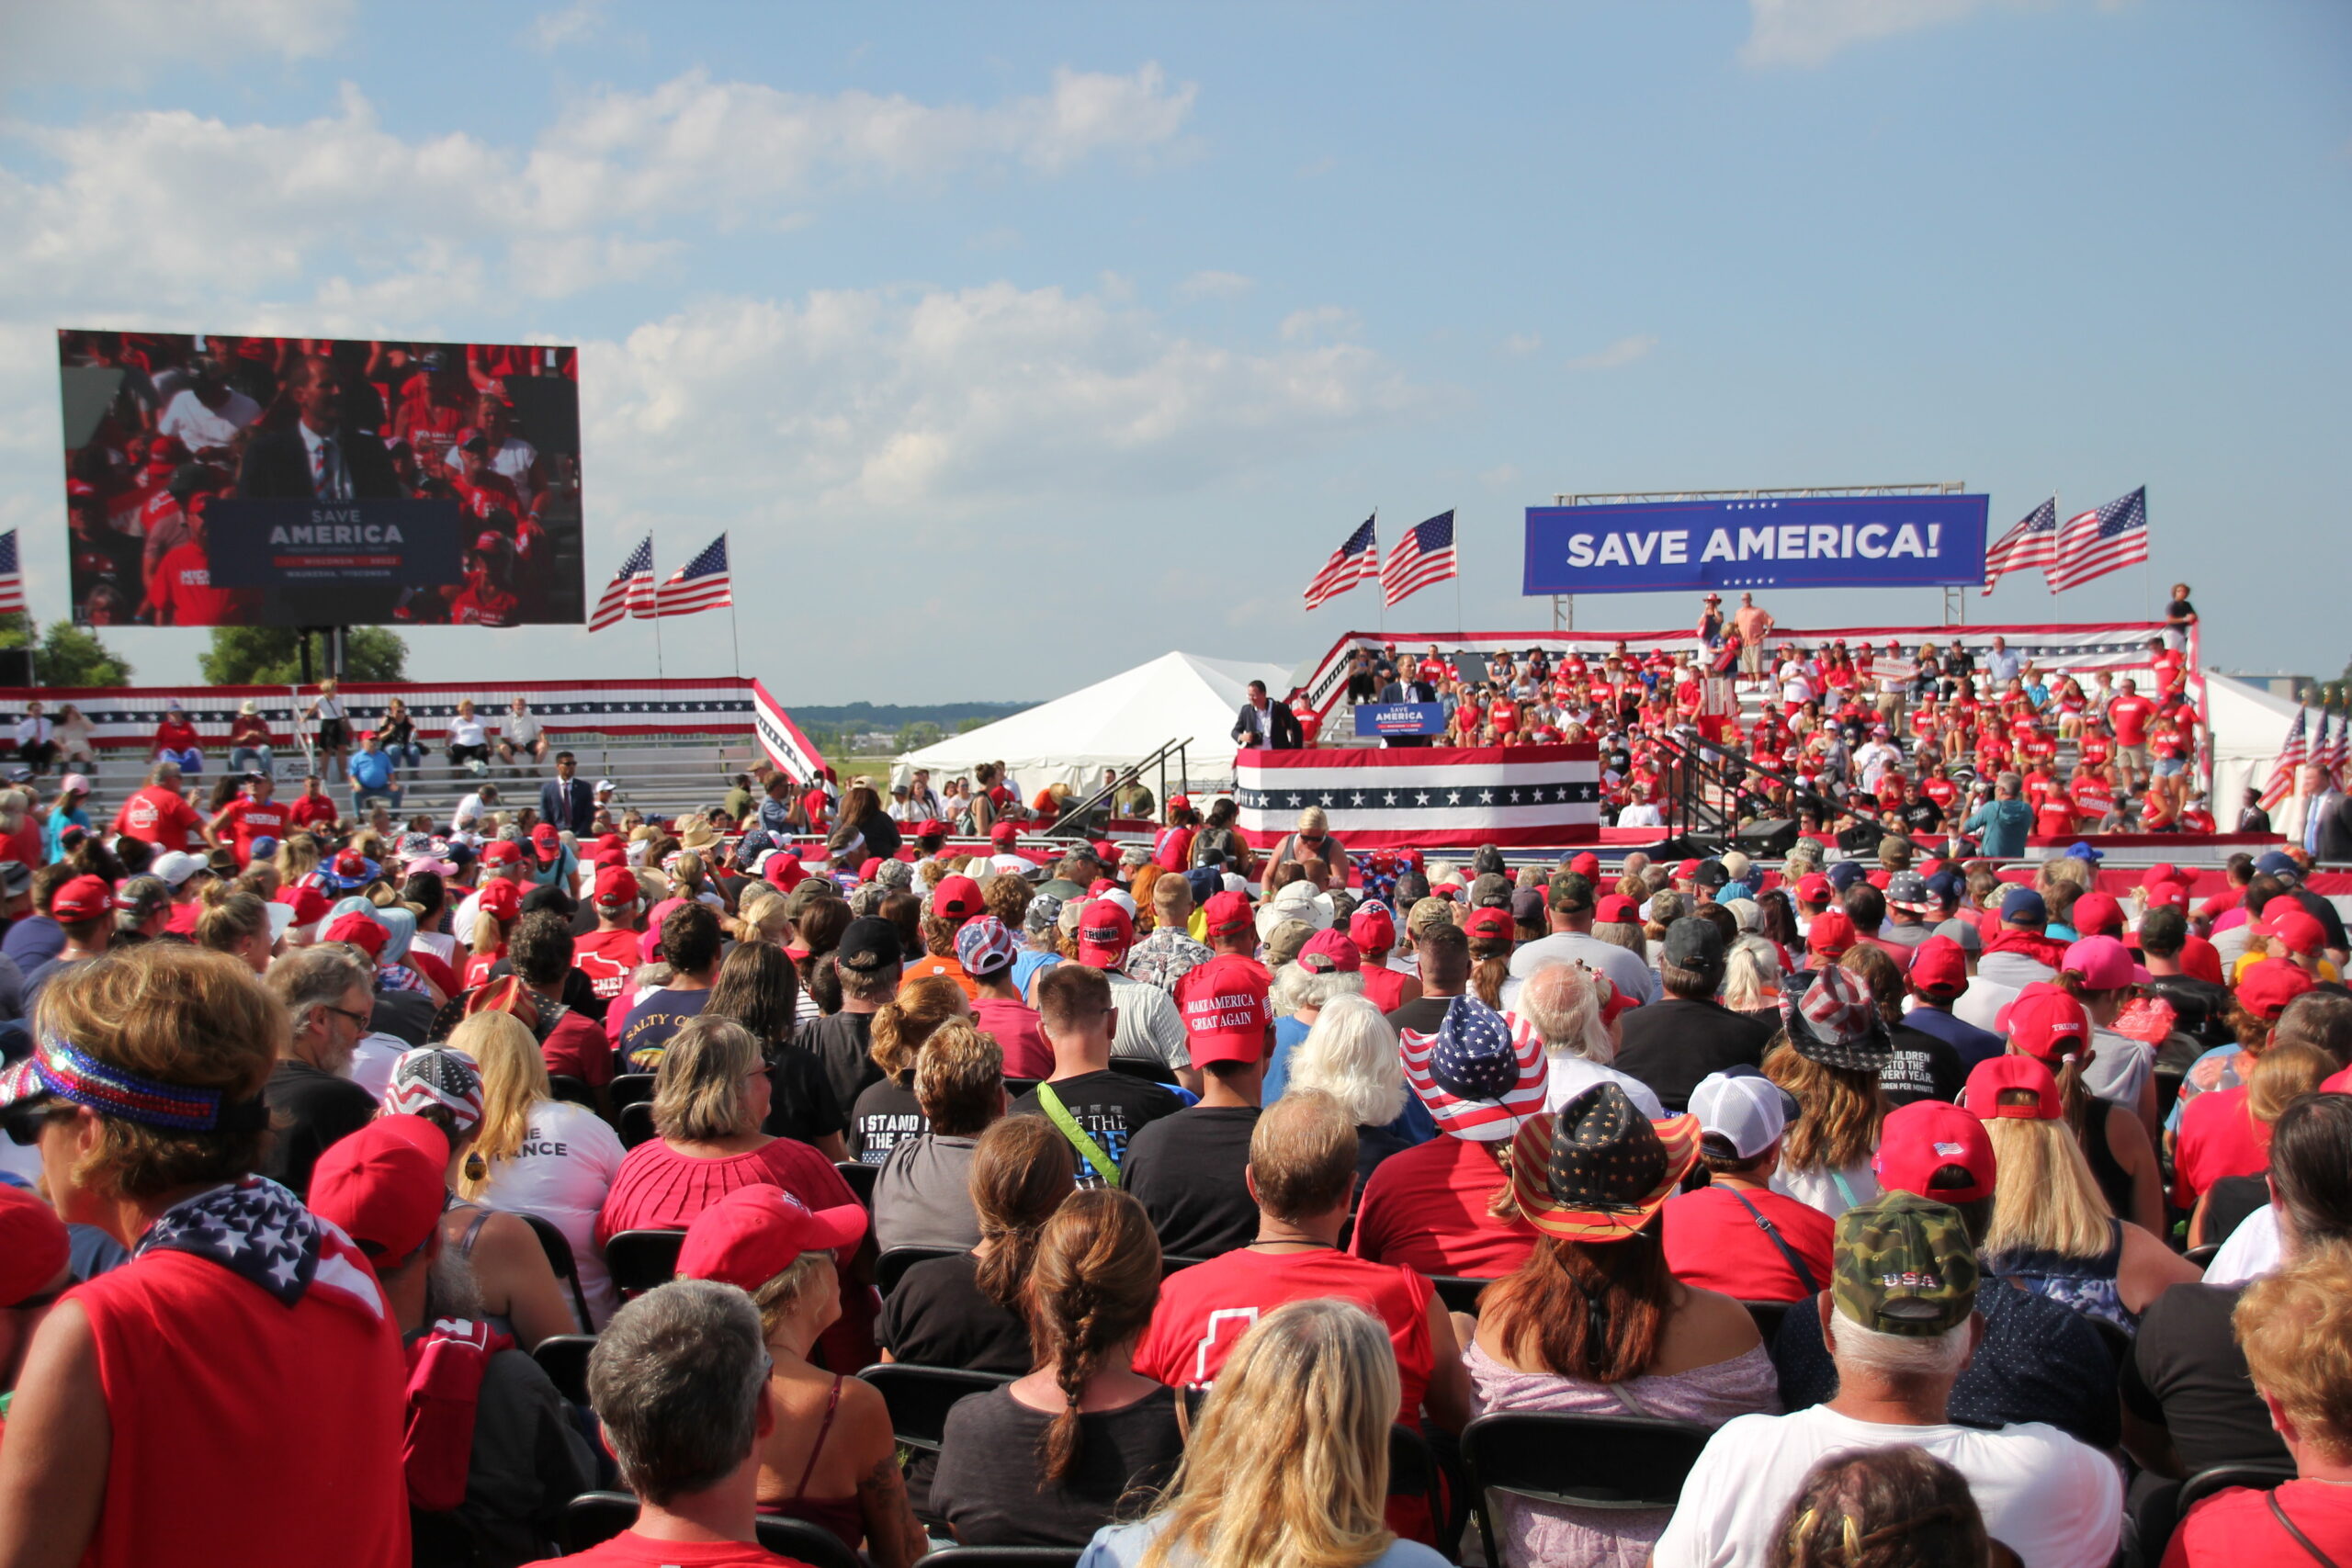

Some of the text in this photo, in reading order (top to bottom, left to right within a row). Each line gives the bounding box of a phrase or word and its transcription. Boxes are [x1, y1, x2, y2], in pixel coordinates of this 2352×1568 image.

[311, 509, 361, 524] SAVE
[269, 525, 404, 544] AMERICA
[1566, 524, 1940, 568] SAVE AMERICA!
[1375, 712, 1424, 722] AMERICA
[1083, 929, 1118, 940] TRUMP
[1187, 994, 1255, 1014] MAKE AMERICA
[625, 1013, 671, 1042] SALTY
[1192, 1011, 1251, 1031] GREAT AGAIN
[2051, 1022, 2079, 1032] TRUMP
[1906, 1060, 1925, 1071] THE
[1907, 1070, 1934, 1084] YEAR.
[1899, 1082, 1912, 1090] PER
[1912, 1084, 1934, 1094] MINUTE
[860, 1116, 865, 1133] I
[867, 1114, 920, 1132] STAND
[1088, 1114, 1127, 1131] THE
[866, 1132, 895, 1149] THE
[1882, 1271, 1938, 1288] USA
